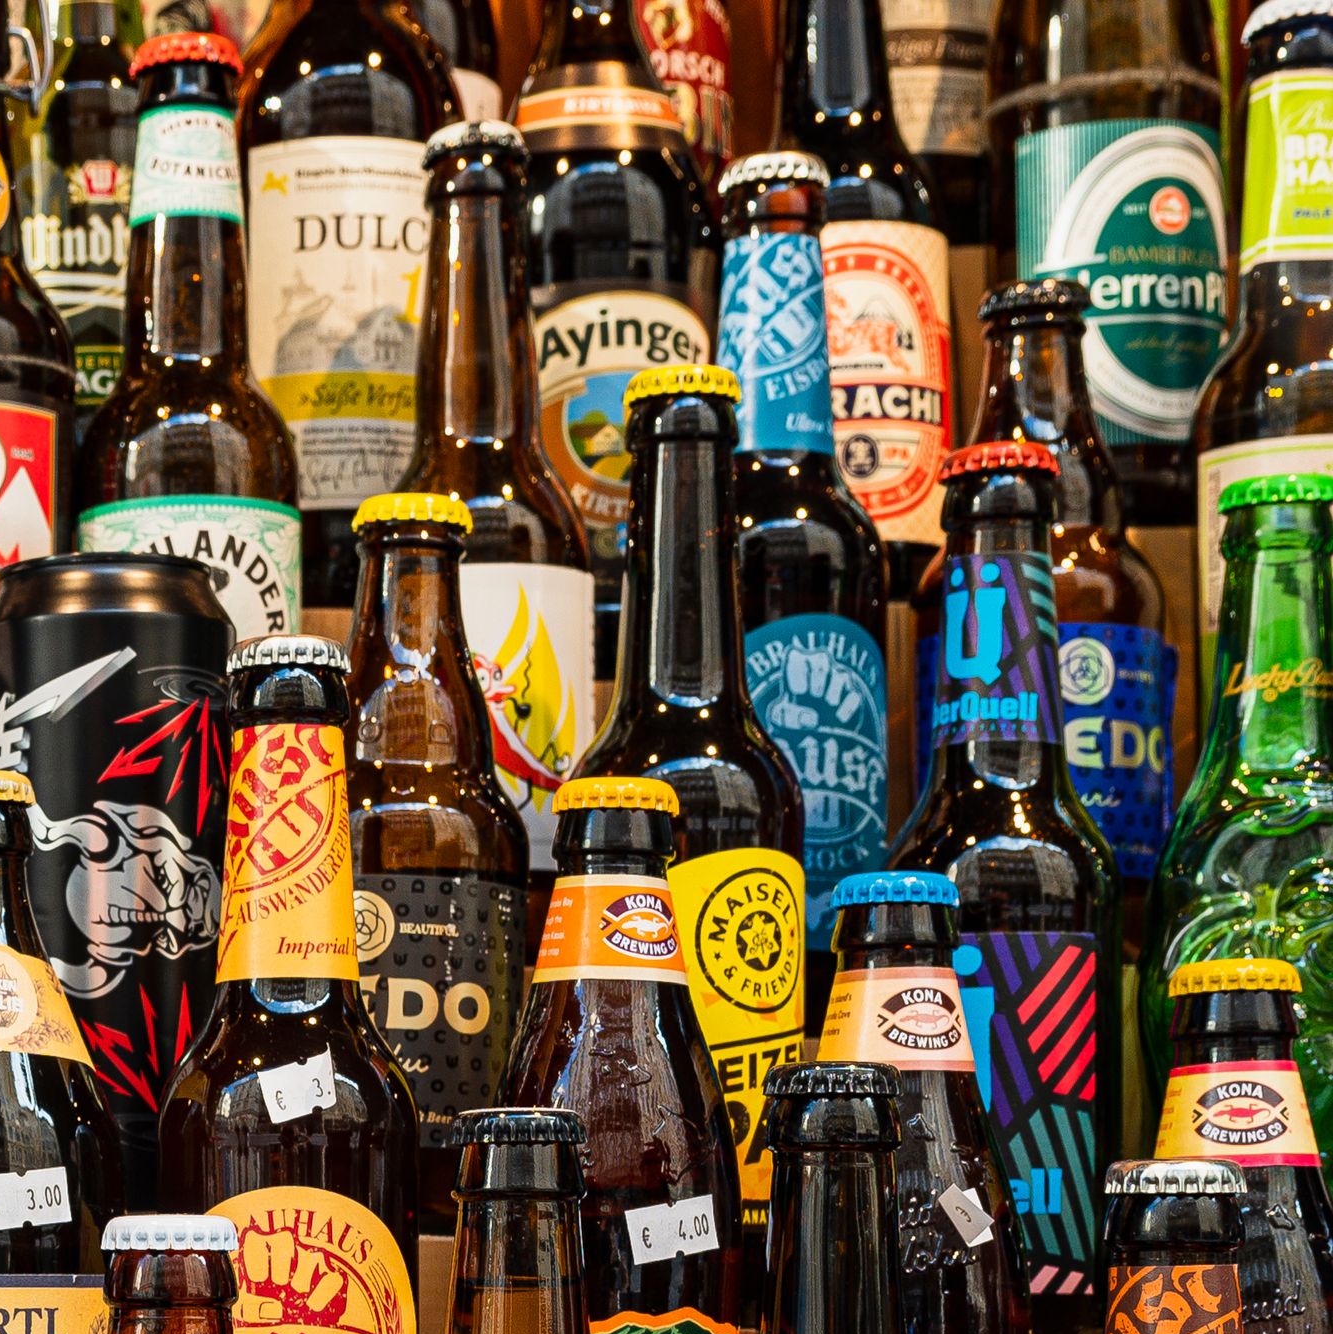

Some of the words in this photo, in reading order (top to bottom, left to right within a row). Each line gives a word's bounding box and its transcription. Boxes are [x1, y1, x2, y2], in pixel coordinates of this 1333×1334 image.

[296, 213, 429, 255] DULC
[540, 310, 702, 367] Ayinger
[625, 895, 666, 910] KONA
[707, 884, 794, 944] MAISEL
[276, 934, 349, 957] Imperial
[610, 931, 662, 957] BREWING
[739, 945, 795, 999] FRIENDS
[901, 989, 943, 1006] KONA
[888, 1029, 949, 1049] BREWING
[276, 1089, 286, 1111] €
[1216, 1082, 1263, 1099] KONA
[1200, 1125, 1268, 1144] BREWING
[27, 1184, 63, 1211] 3.00
[642, 1227, 651, 1249] €
[678, 1214, 710, 1240] 4.00
